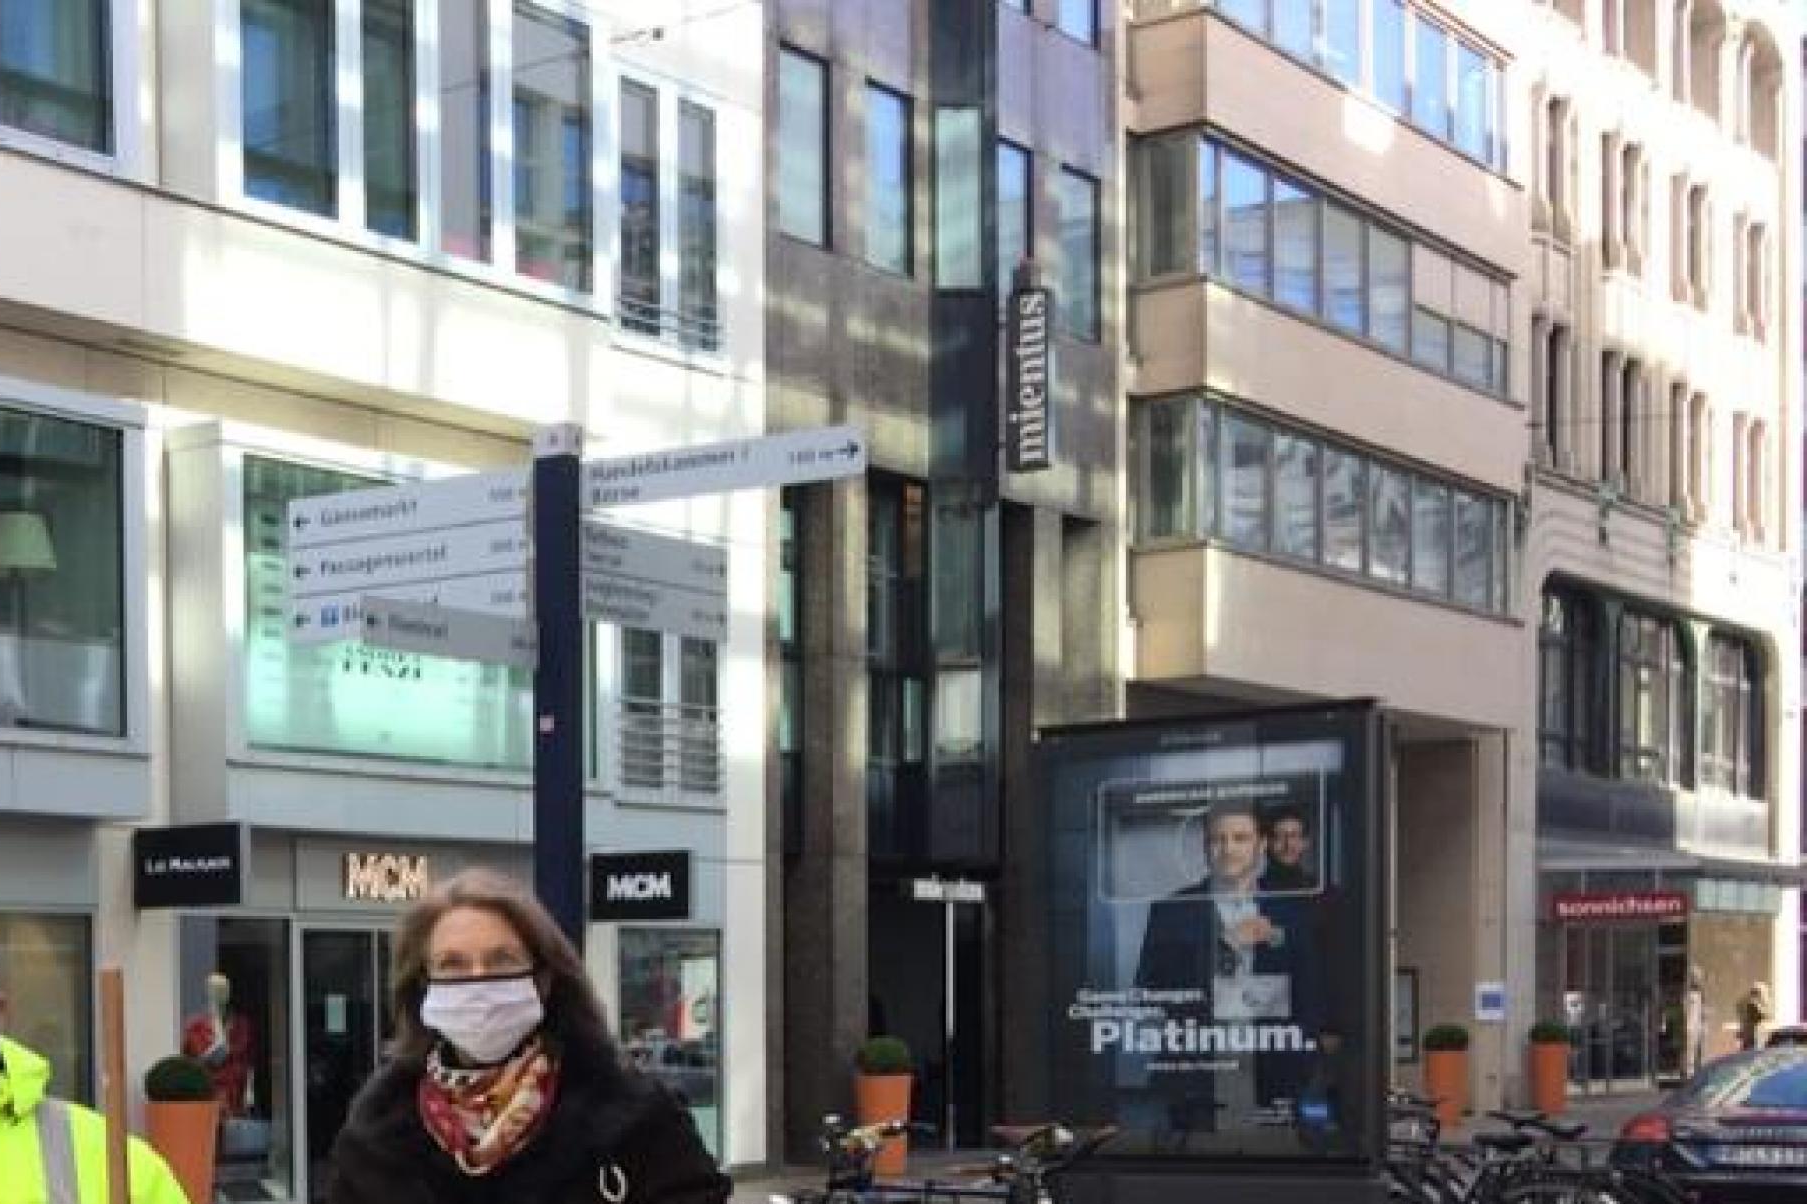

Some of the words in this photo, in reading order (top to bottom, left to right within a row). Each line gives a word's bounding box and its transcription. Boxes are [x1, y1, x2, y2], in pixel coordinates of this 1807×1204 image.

[1009, 294, 1045, 463] mientus
[342, 852, 429, 901] MCM
[606, 872, 671, 898] MCM
[1093, 1019, 1317, 1053] Platinum.
